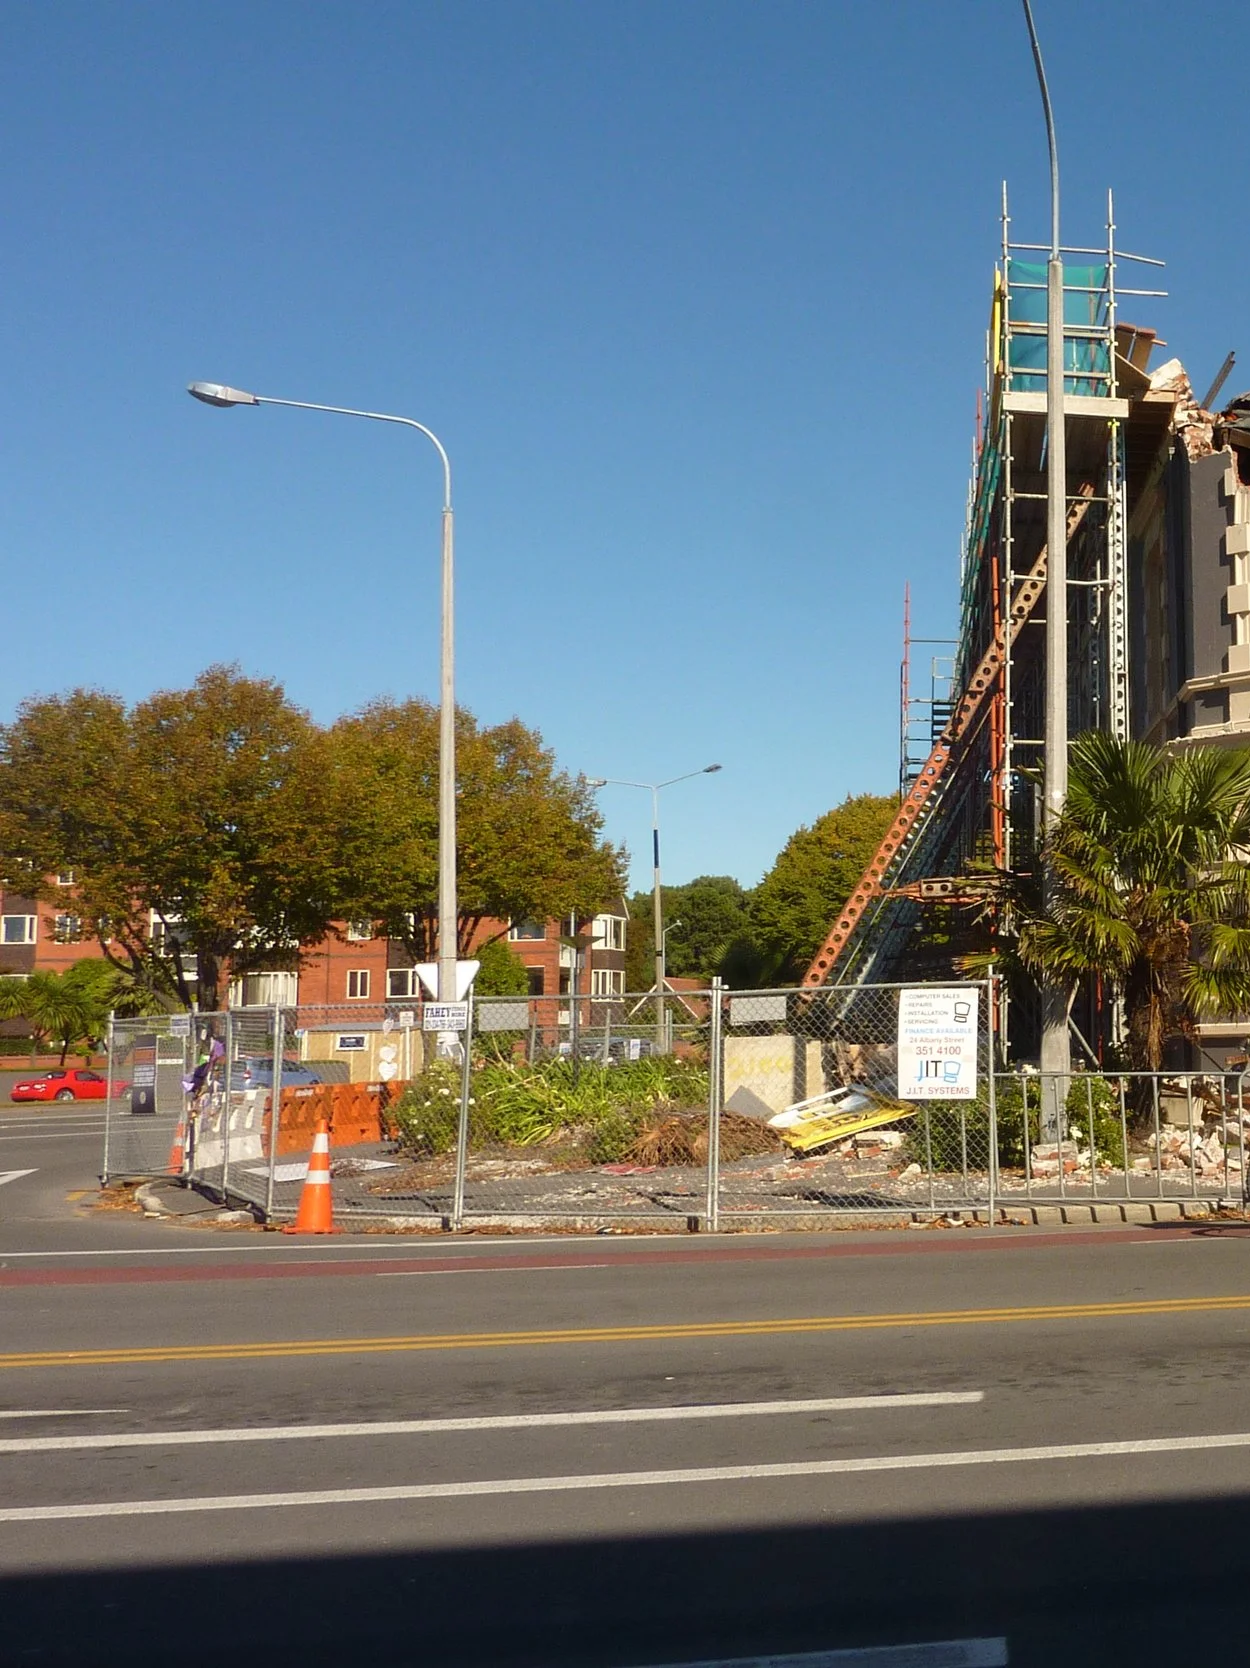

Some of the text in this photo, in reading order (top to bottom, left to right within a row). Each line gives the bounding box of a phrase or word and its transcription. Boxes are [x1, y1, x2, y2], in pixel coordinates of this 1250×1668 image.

[916, 1046, 961, 1055] 351 4100
[917, 1060, 942, 1082] JIT
[928, 1087, 970, 1095] SYSTEMS
